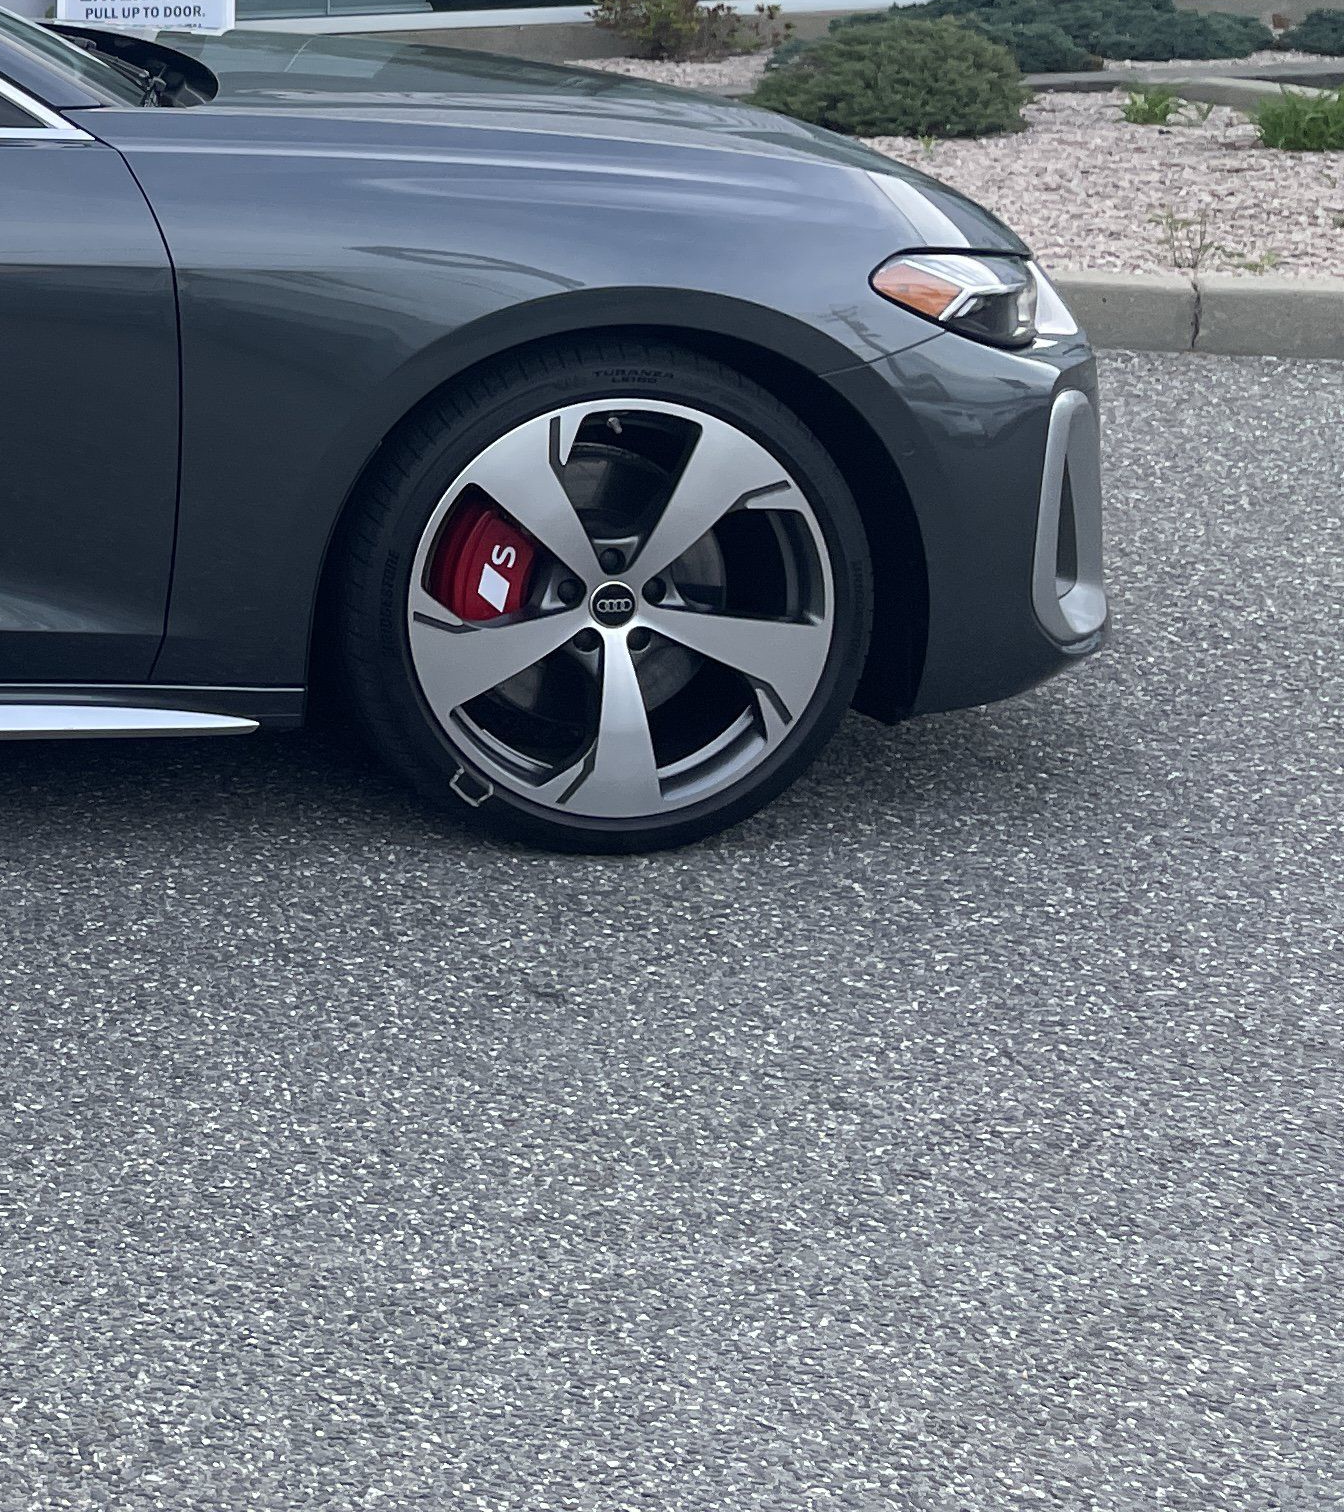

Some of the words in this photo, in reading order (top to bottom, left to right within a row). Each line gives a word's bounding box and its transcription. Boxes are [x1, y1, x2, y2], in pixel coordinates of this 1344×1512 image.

[85, 7, 118, 19] PULL
[122, 7, 140, 19] UP
[143, 6, 159, 18] TO
[163, 5, 206, 18] DOOR.
[491, 544, 516, 568] S
